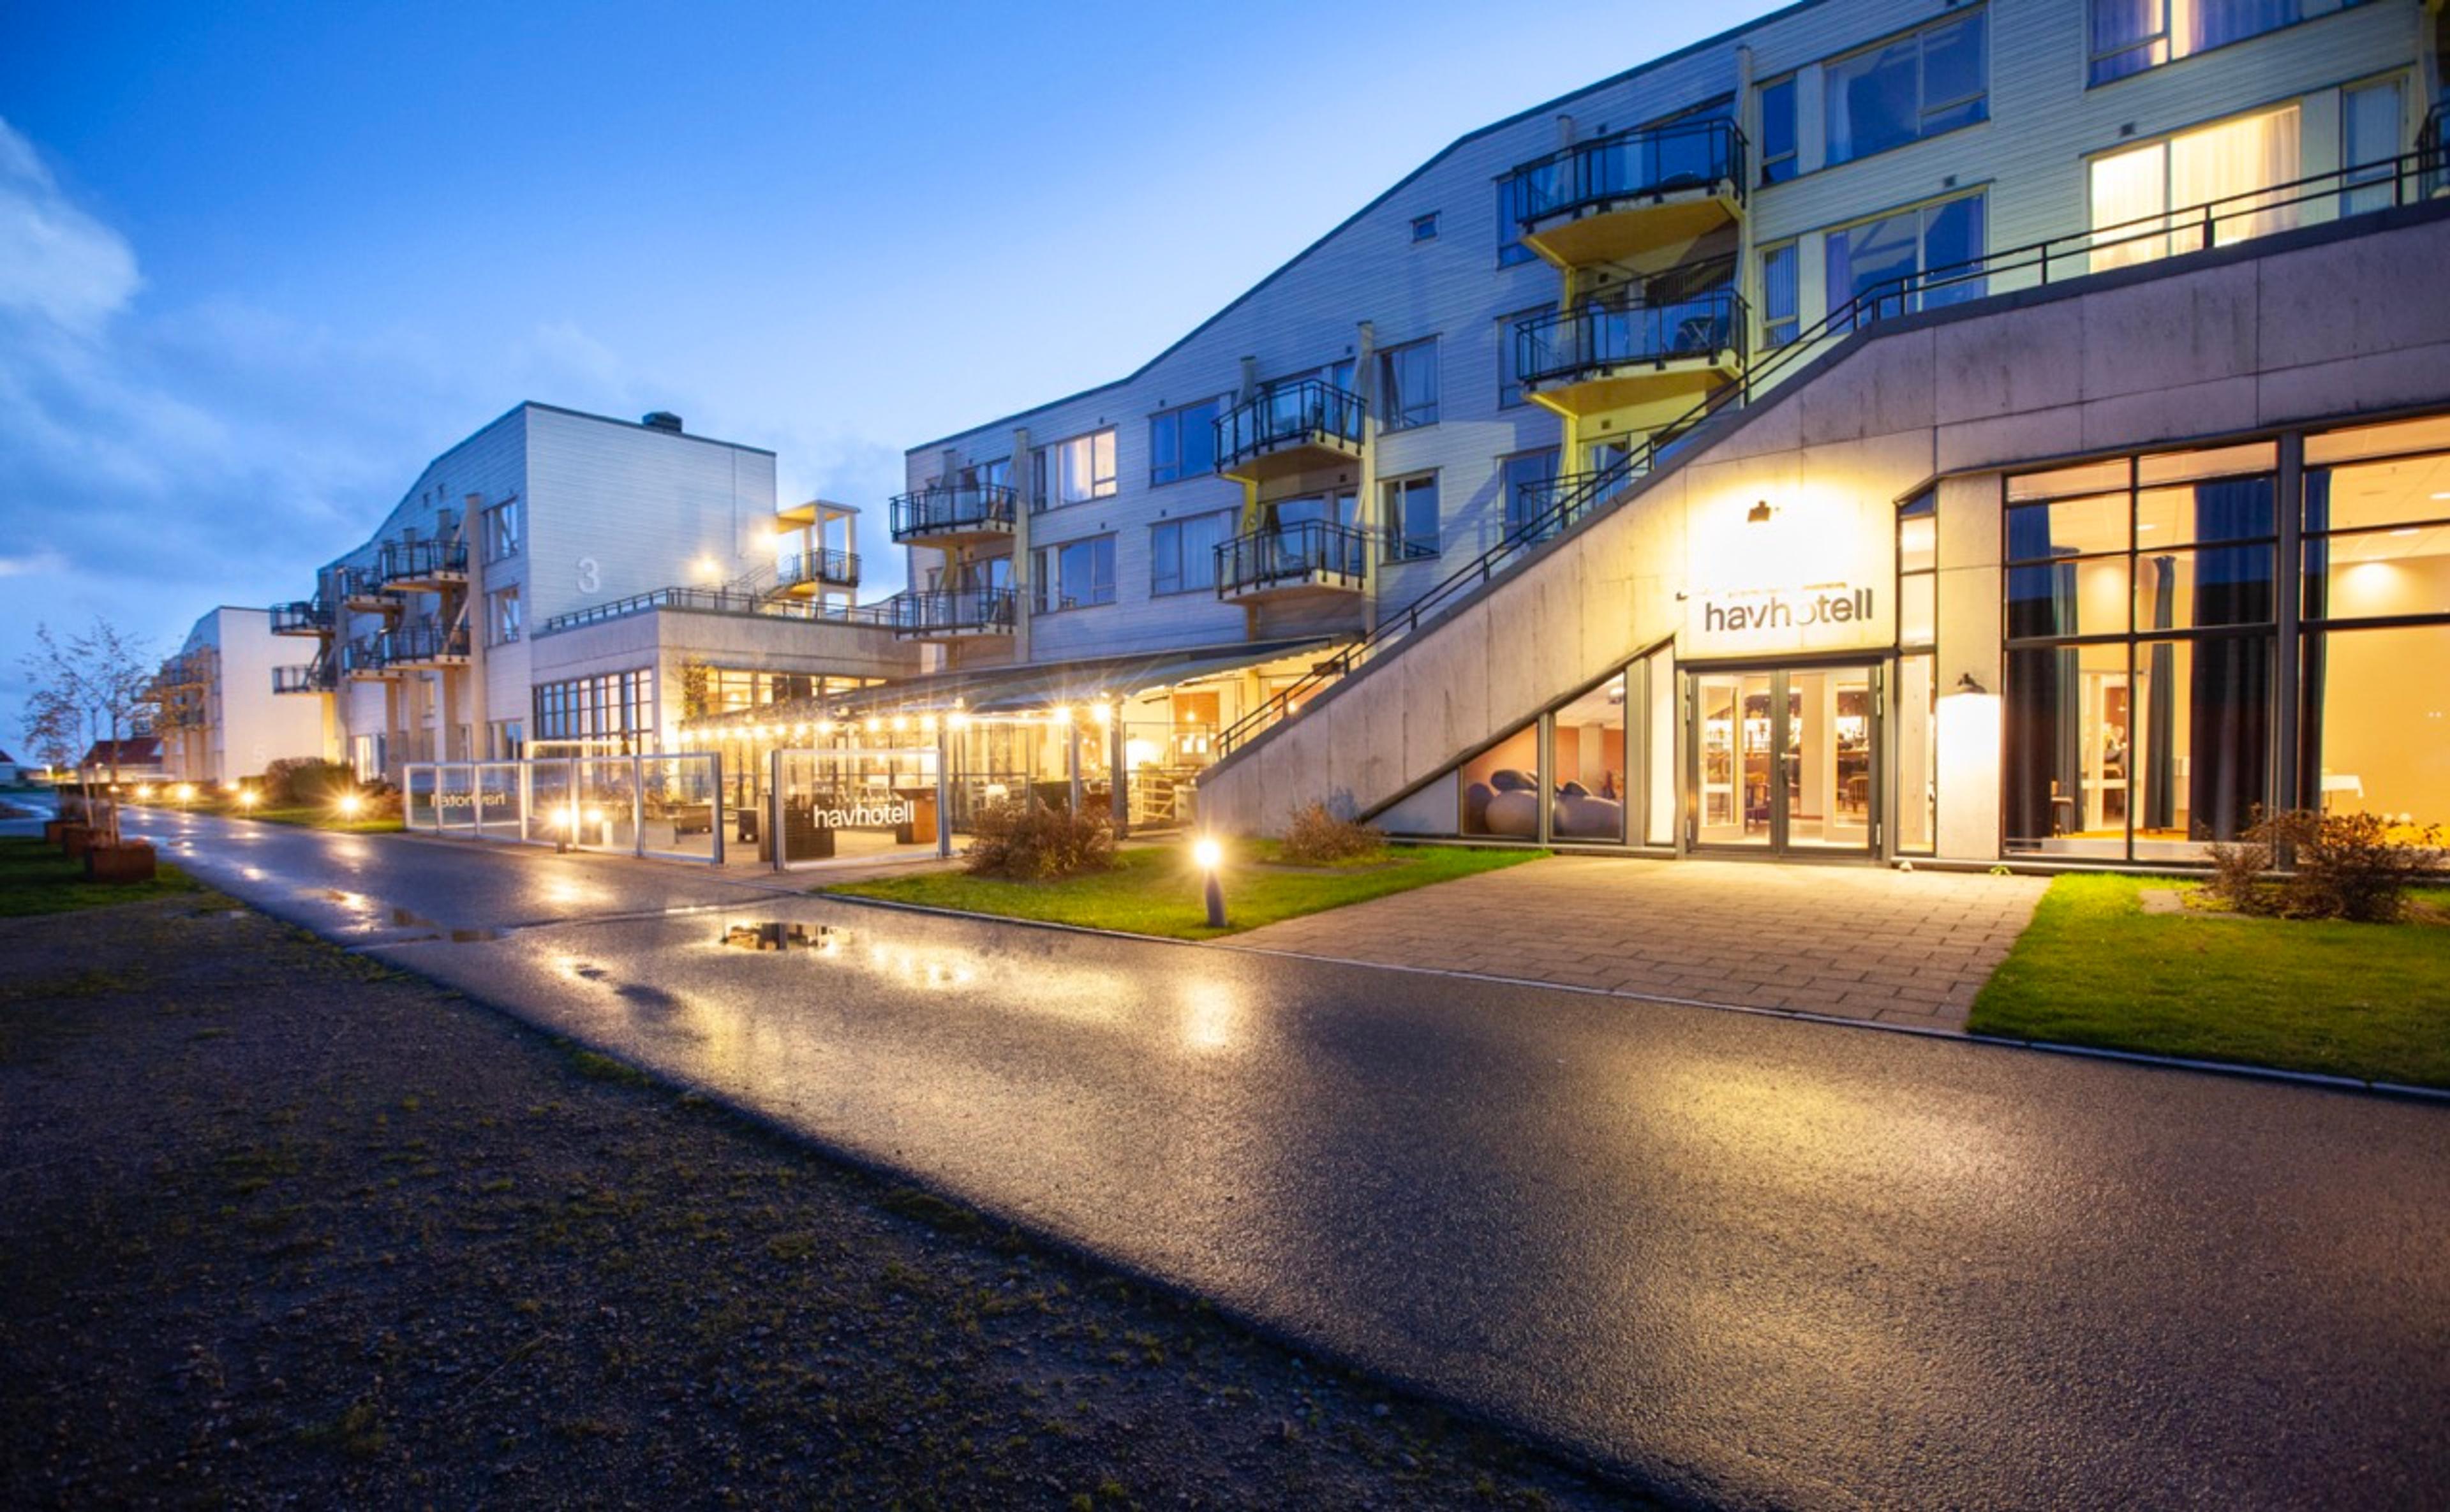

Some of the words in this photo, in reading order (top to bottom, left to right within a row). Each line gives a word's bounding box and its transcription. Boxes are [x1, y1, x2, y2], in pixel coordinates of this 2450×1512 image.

[578, 558, 599, 593] 3
[1705, 588, 1873, 632] havhotell
[813, 800, 914, 827] havhotell
